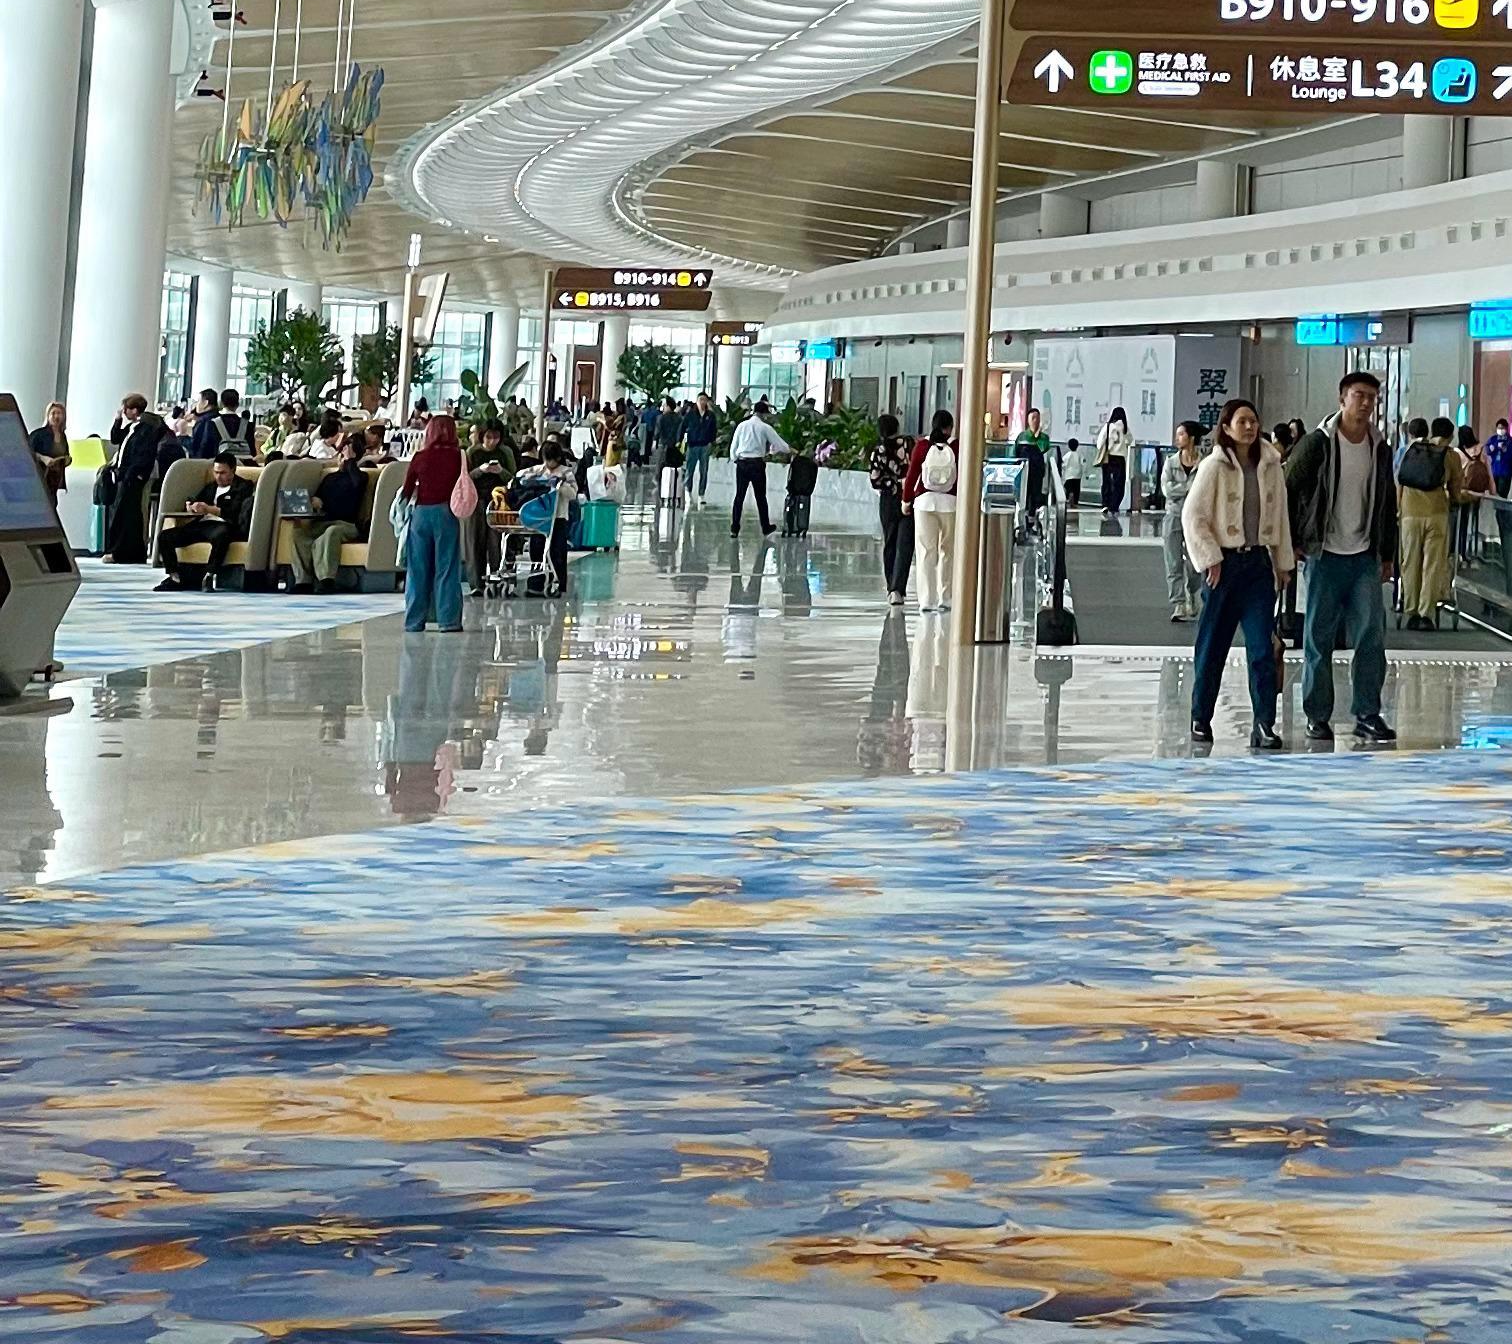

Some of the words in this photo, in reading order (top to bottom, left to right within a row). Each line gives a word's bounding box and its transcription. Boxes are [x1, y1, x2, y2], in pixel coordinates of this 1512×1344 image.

[1138, 52, 1207, 71] 医疗急救
[1269, 55, 1348, 83] 休息室
[1138, 71, 1183, 82] MEDICAL
[1184, 72, 1210, 82] FIRST
[1211, 72, 1231, 83] AID
[1351, 59, 1428, 99] L34
[1291, 84, 1347, 103] Lounge
[613, 271, 676, 286] B910-914
[627, 292, 661, 307] B916
